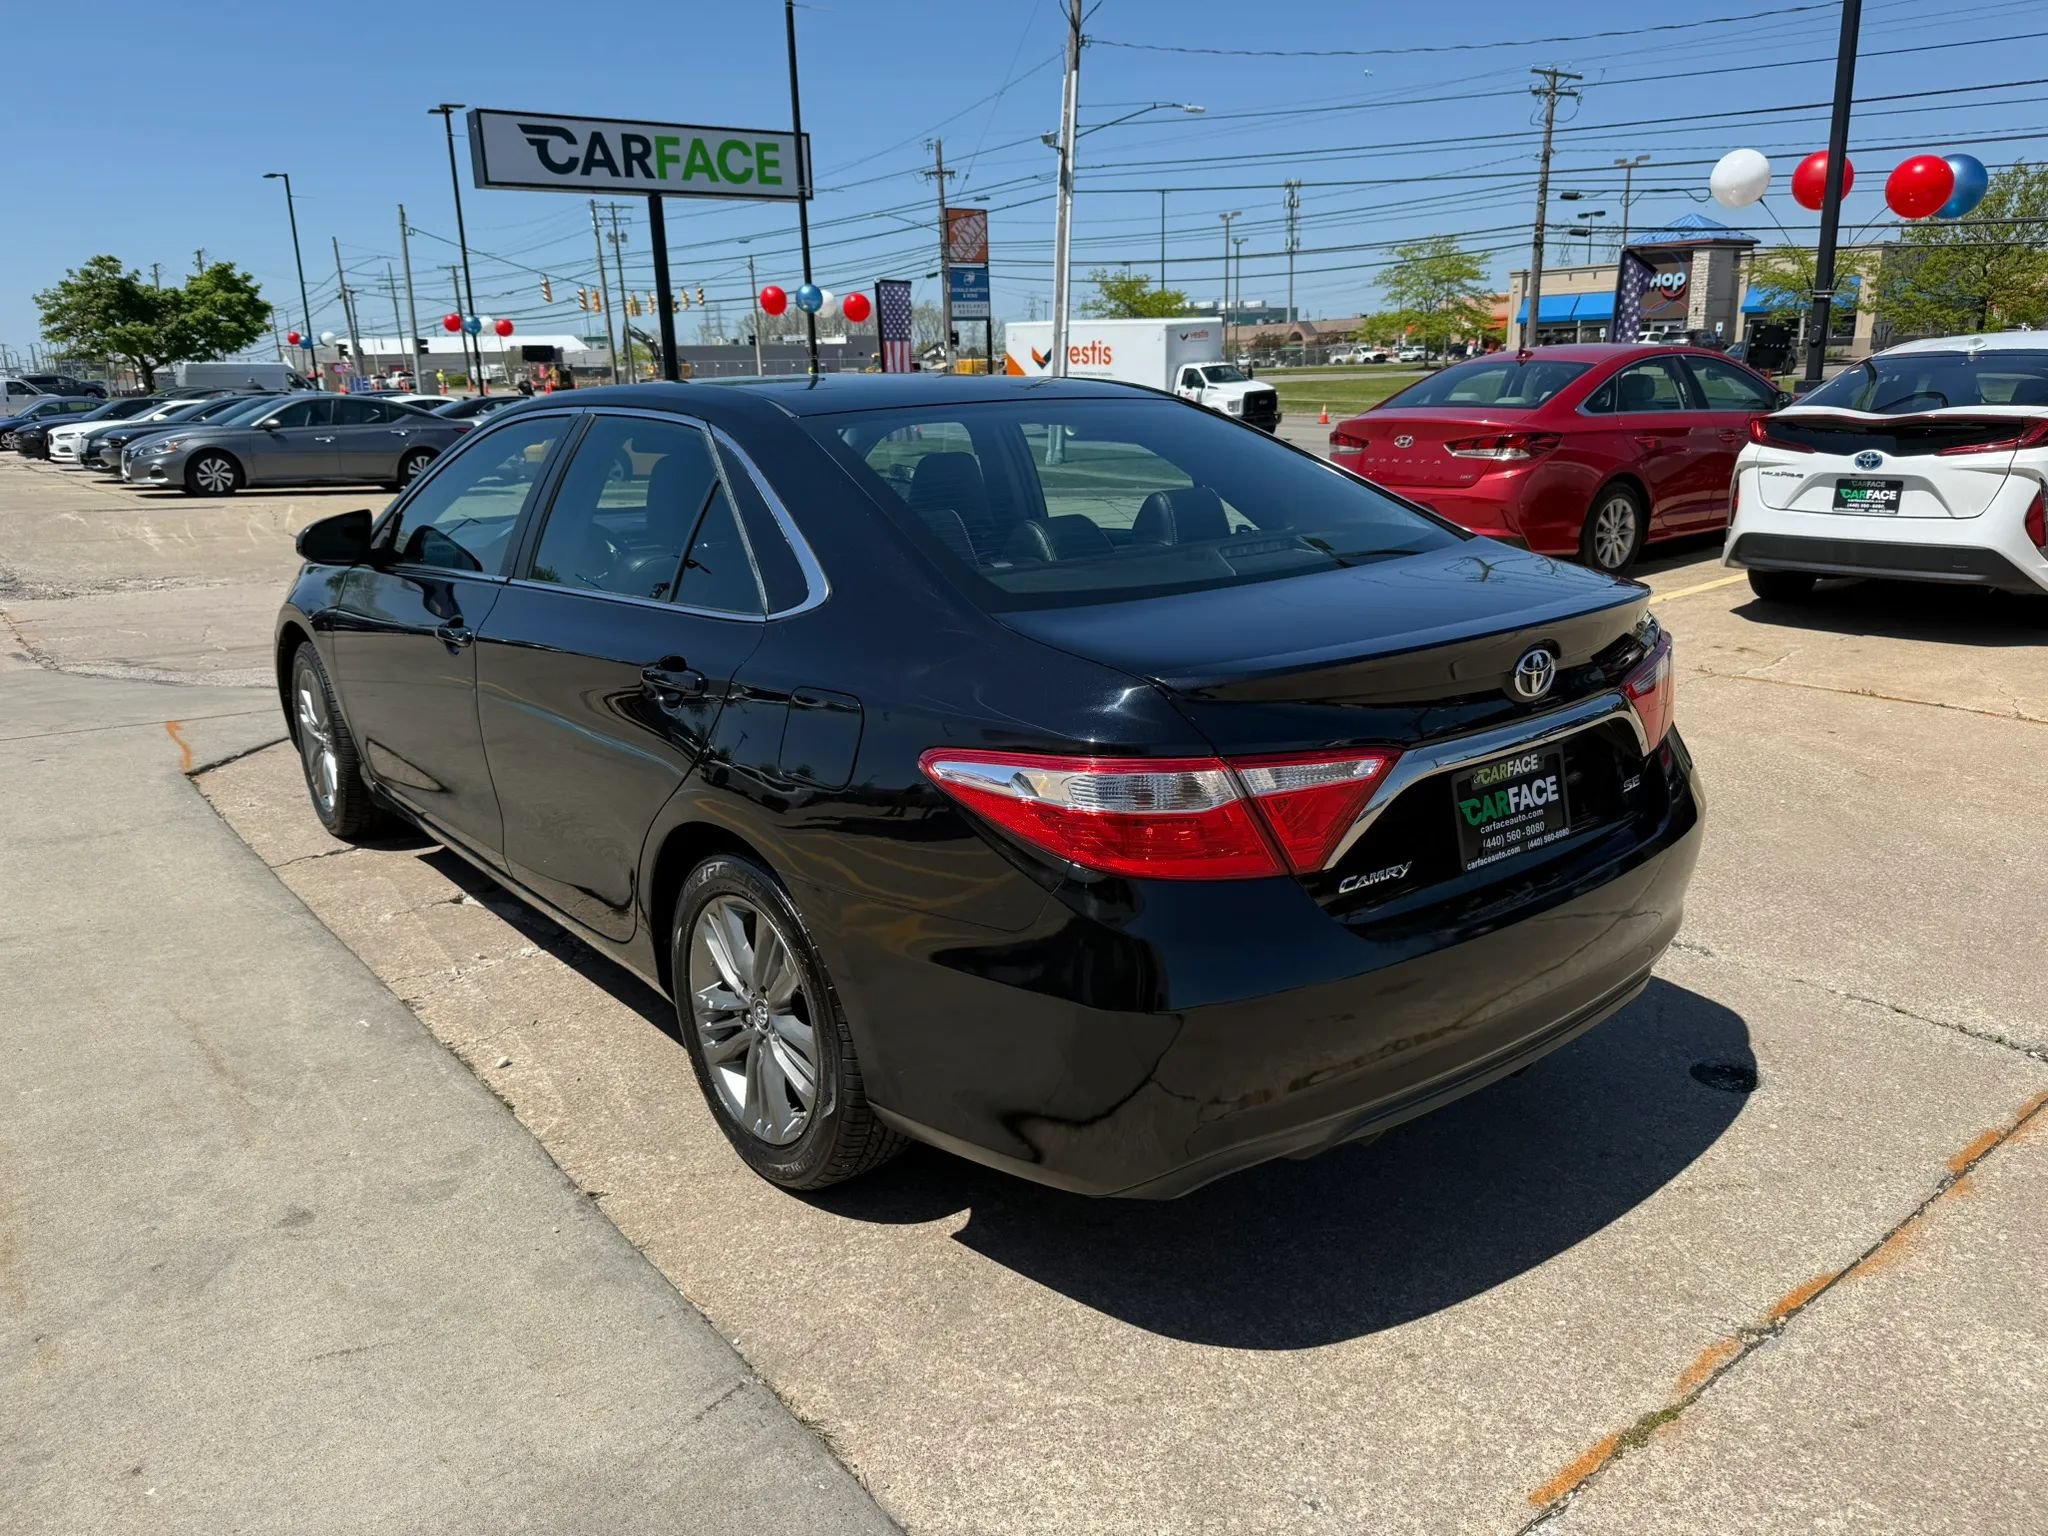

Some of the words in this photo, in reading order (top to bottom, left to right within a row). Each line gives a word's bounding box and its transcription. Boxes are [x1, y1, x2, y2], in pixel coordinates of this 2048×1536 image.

[517, 123, 783, 185] CARFACE
[1067, 340, 1112, 365] estis
[1840, 488, 1897, 500] CARFACE
[1476, 754, 1539, 784] CARFACE
[1623, 774, 1641, 793] SE
[1458, 775, 1559, 826] CARFACE
[1480, 808, 1544, 834] carfaceauto.com
[1466, 845, 1521, 871] carfaceauto.com
[1527, 837, 1543, 850] (440)
[1483, 834, 1505, 849] (440)
[1338, 861, 1413, 894] CAMRY
